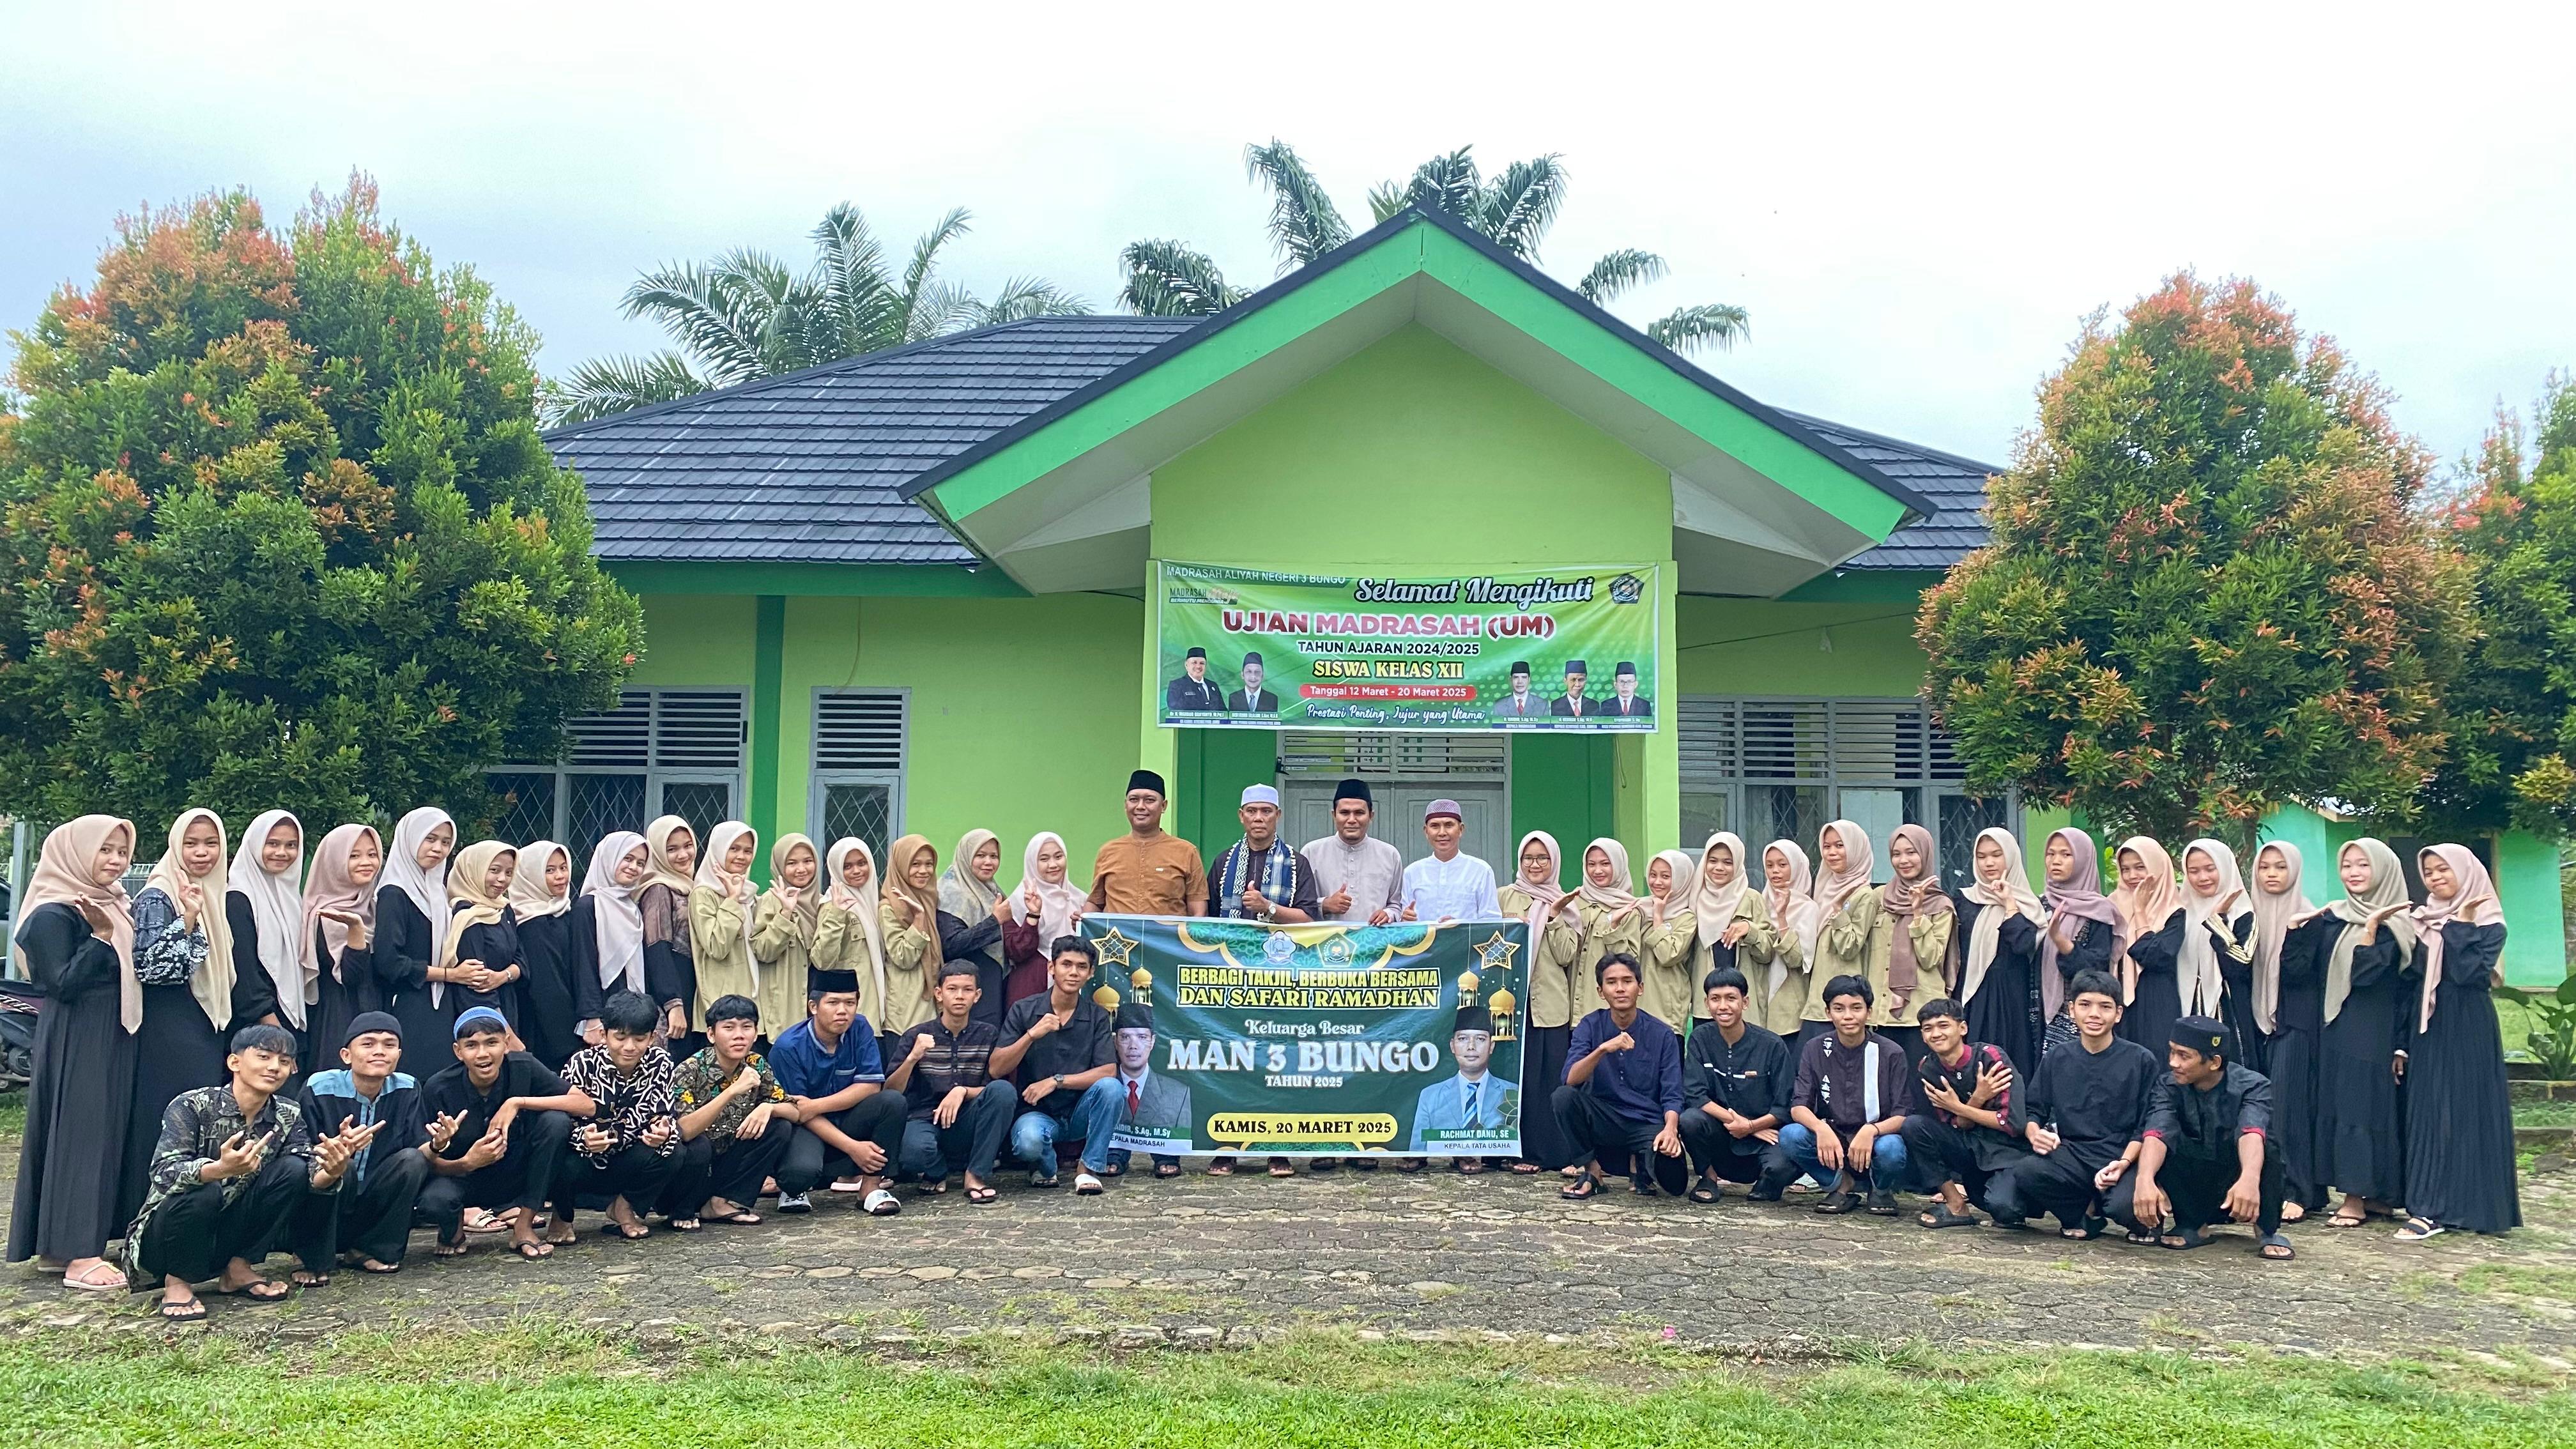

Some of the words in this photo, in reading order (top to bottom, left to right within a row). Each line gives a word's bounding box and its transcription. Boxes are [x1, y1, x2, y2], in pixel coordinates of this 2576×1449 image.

[1167, 565, 1222, 579] MADRASAH
[1224, 571, 1259, 581] ALIYAH
[1262, 572, 1298, 583] NEGERI
[1309, 575, 1346, 584] BUNGO
[1170, 587, 1207, 597] MADRASAH
[1354, 578, 1460, 603] Selamat
[1465, 576, 1595, 611] Mengikuti
[1223, 611, 1308, 633] UJIAN
[1315, 616, 1480, 636] MADRASAH
[1487, 616, 1555, 640] (UM)
[1298, 641, 1344, 653] TAHUN
[1347, 642, 1403, 654] AJARAN
[1406, 643, 1480, 656] 2024/2025
[1314, 661, 1368, 678] SISWA
[1375, 661, 1432, 678] KELAS
[1437, 662, 1464, 678] XII
[1310, 686, 1346, 697] Tanggal
[1349, 687, 1358, 695] 12
[1361, 687, 1388, 696] Maret
[1398, 687, 1410, 696] 20
[1413, 687, 1439, 696] Maret
[1442, 688, 1467, 697] 2025
[1306, 704, 1347, 718] Prestasi
[1349, 707, 1390, 723] Penting,
[1392, 707, 1420, 723] Jujur
[1423, 712, 1448, 724] yang
[1452, 707, 1485, 720] Utama
[1180, 969, 1243, 985] BERBAGI
[1246, 970, 1297, 988] TAKJIL,
[1296, 971, 1367, 987] BERBUKA
[1370, 970, 1438, 987] BERSAMA
[1179, 988, 1224, 1004] DAN
[1229, 988, 1308, 1006] SAFARI
[1313, 990, 1438, 1007] RAMADHAN
[1245, 1019, 1317, 1038] Keluarga
[1319, 1020, 1365, 1036] Besar
[1167, 1039, 1257, 1071] MAN
[1266, 1043, 1286, 1072] 3
[1298, 1041, 1439, 1072] BUNGO
[1265, 1075, 1313, 1087] TAHUN
[1315, 1077, 1344, 1087] 2025
[1135, 1126, 1152, 1137] S.Ag,
[1153, 1128, 1170, 1138] M.Sy
[1214, 1121, 1271, 1134] KAMIS,
[1276, 1123, 1293, 1133] 20
[1297, 1121, 1353, 1133] MARET
[1358, 1123, 1391, 1133] 2025
[1440, 1130, 1474, 1138] RACHMAT
[1476, 1130, 1498, 1139] DANU,
[1130, 1138, 1165, 1147] MADRASAH
